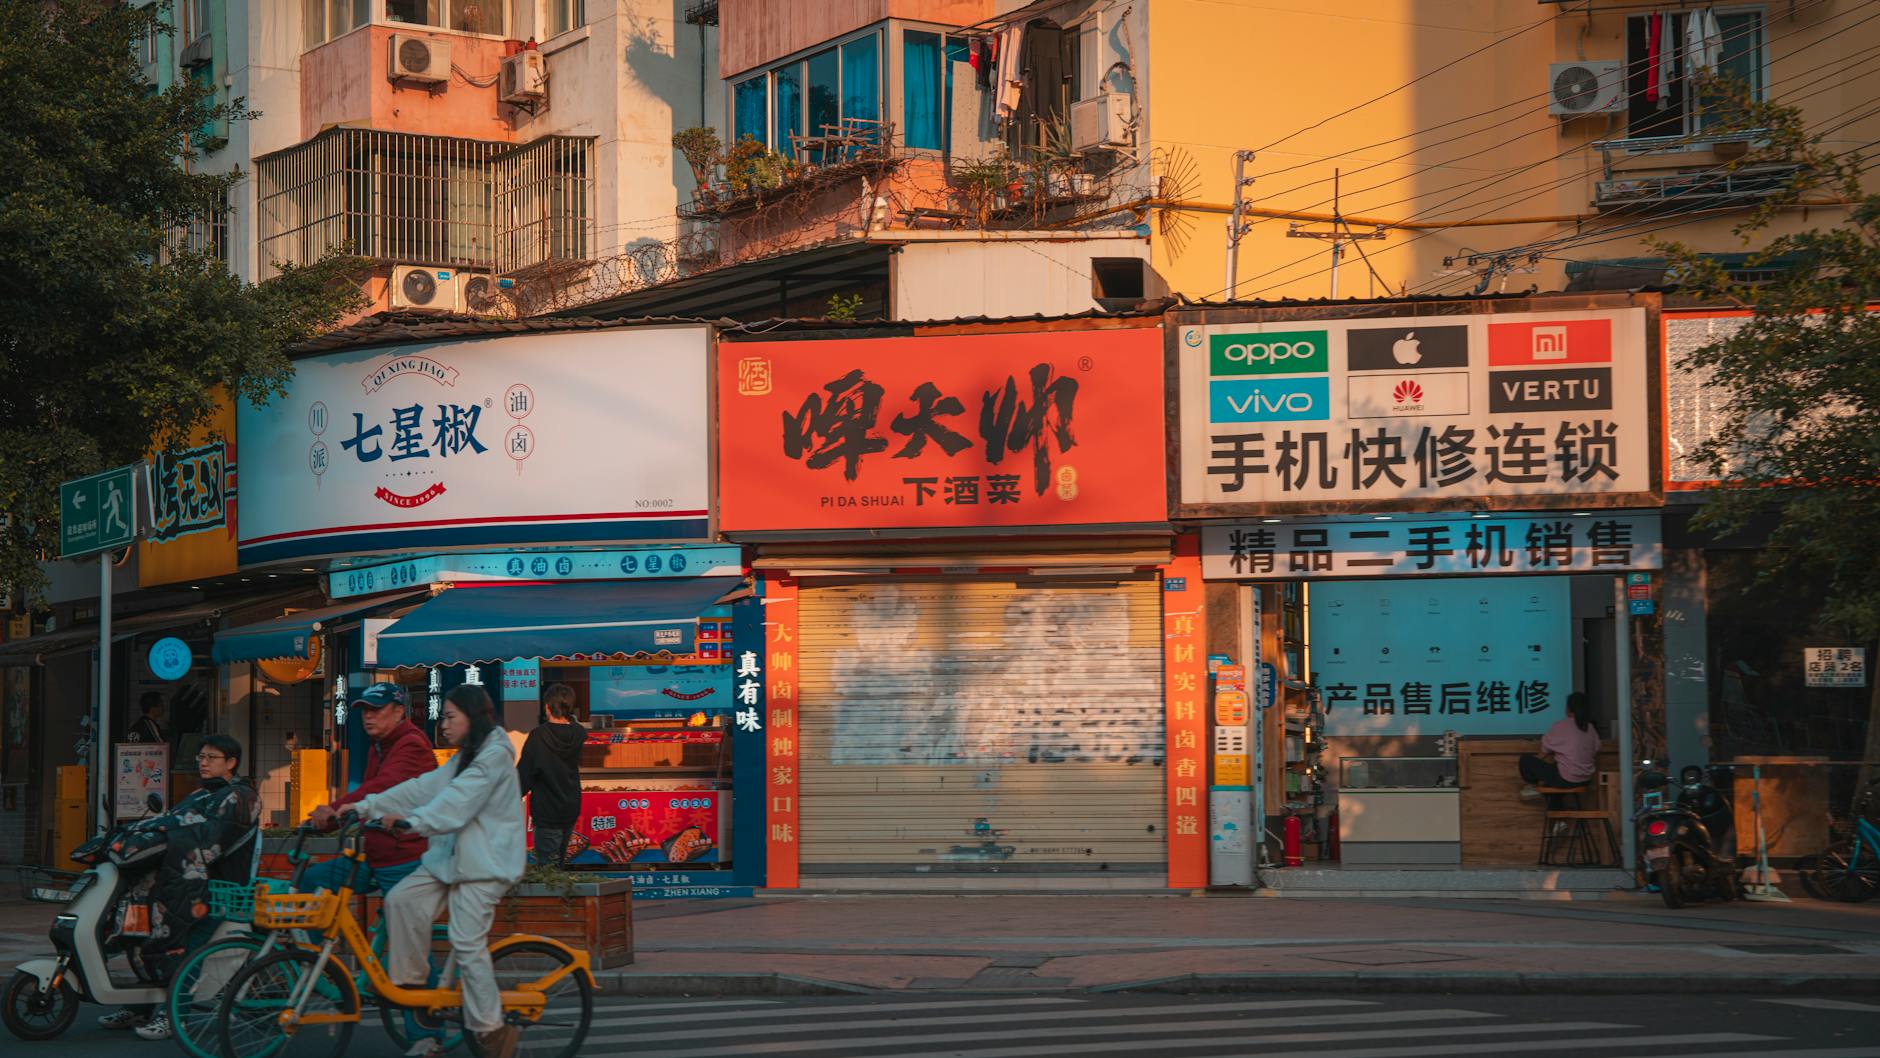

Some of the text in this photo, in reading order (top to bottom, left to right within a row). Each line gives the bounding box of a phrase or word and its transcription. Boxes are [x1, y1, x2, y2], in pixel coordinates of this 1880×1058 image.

[1223, 340, 1316, 366] oppo
[373, 359, 446, 386] QI XING JIAO
[1227, 388, 1313, 414] vivo
[1501, 376, 1600, 402] VERTU
[1392, 404, 1425, 412] HUAWEI
[340, 402, 489, 463] 七星椒
[510, 390, 529, 454] 油卤
[781, 361, 1079, 497] 啤大帅
[312, 407, 326, 469] 川派
[1207, 418, 1620, 493] 手机快修连锁
[384, 491, 411, 506] SINCE
[634, 498, 674, 509] NO:0002
[820, 495, 905, 508] PI DA SHUAI
[902, 473, 1022, 507] 下酒菜
[1228, 520, 1634, 574] 精品二手机销售
[508, 557, 572, 575] 真油卤
[622, 554, 686, 573] 七星椒
[1817, 648, 1853, 661] 招聘
[736, 650, 763, 733] 真有味
[1325, 679, 1551, 716] 产品售后维修
[771, 623, 794, 843] 大帅卤制独家口味
[1173, 615, 1199, 835] 真材实料卤香四溢
[662, 886, 719, 897] ZHEN XIANG
